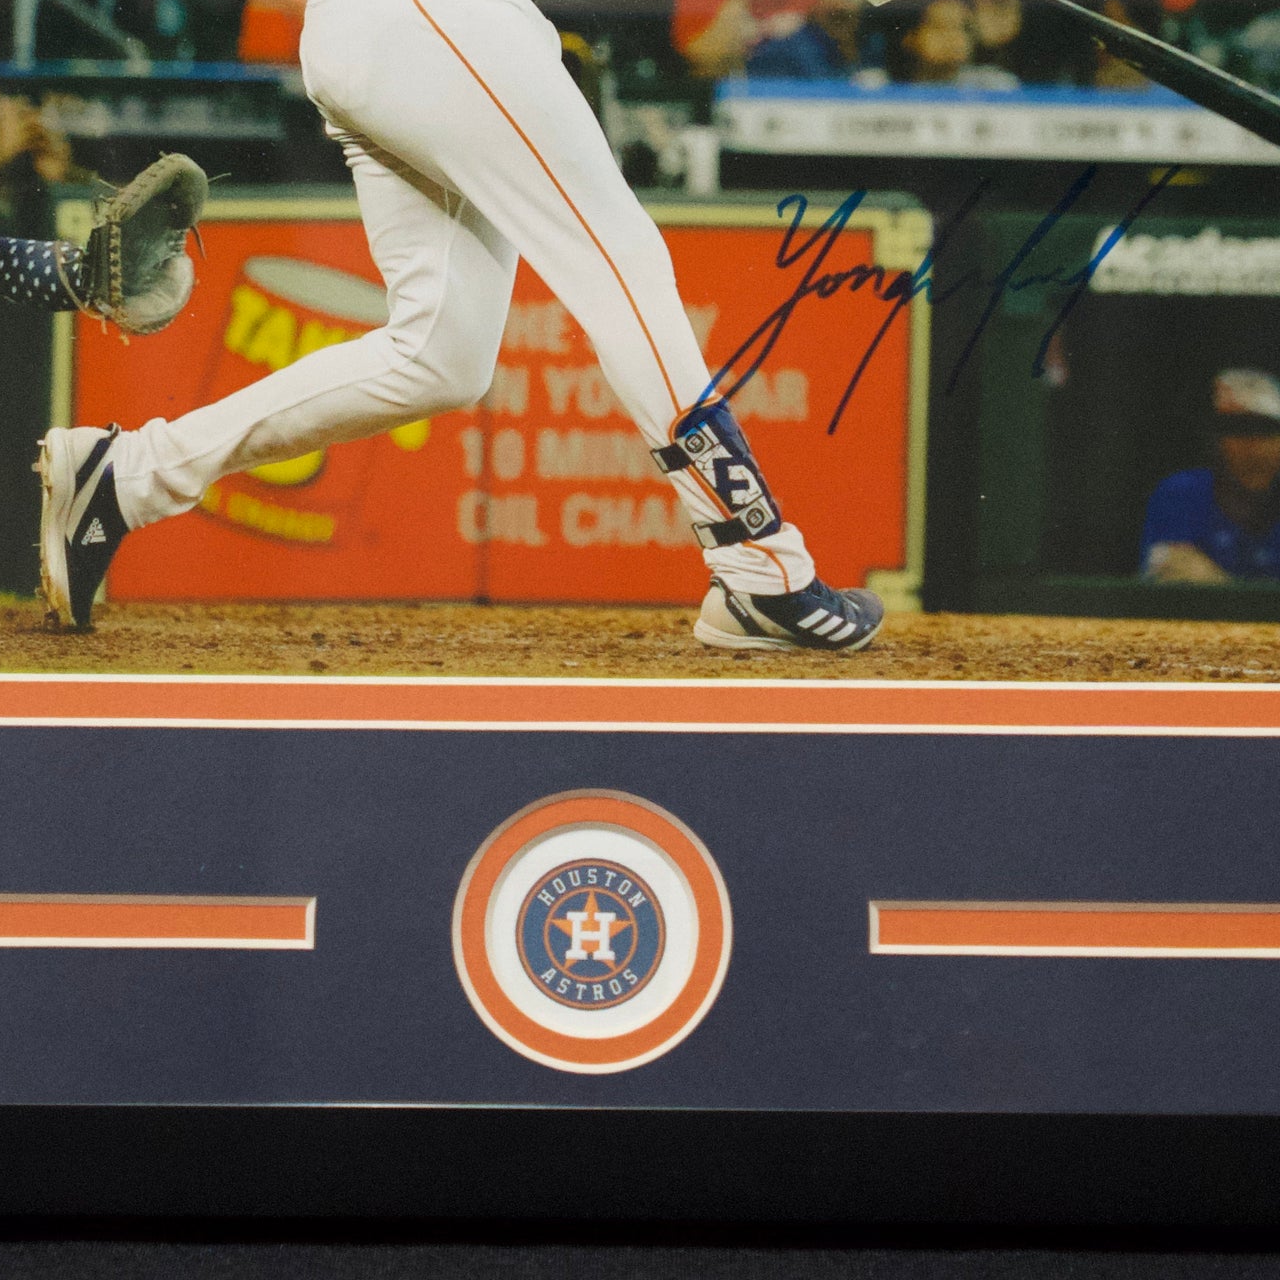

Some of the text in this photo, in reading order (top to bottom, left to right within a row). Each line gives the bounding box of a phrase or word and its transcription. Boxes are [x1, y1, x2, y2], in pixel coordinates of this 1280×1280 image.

[536, 868, 647, 908] HOUSTON
[565, 911, 617, 961] H
[539, 968, 639, 1002] ASTROS
